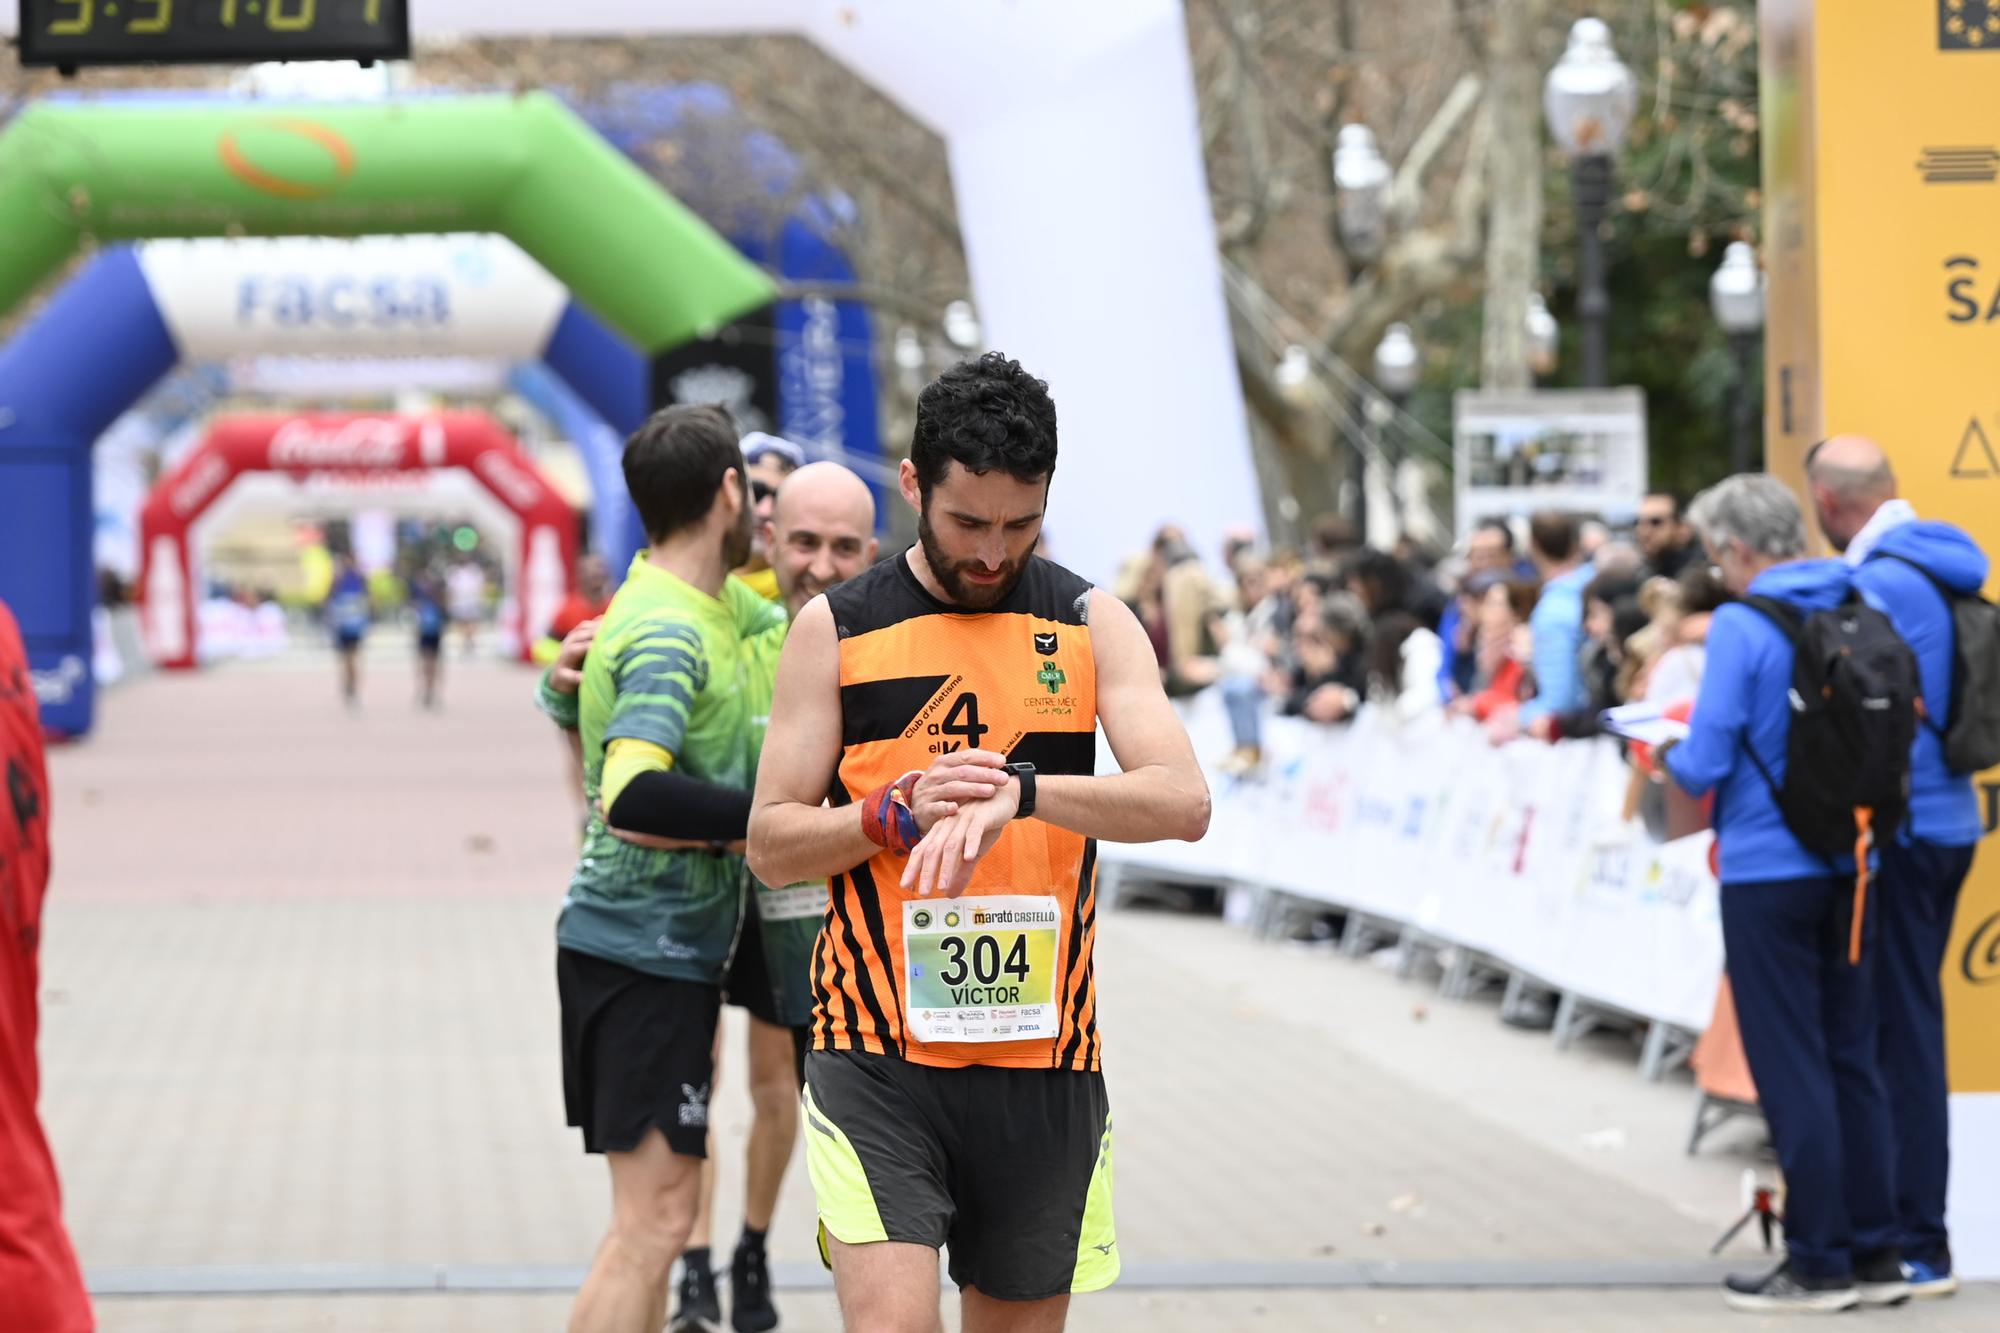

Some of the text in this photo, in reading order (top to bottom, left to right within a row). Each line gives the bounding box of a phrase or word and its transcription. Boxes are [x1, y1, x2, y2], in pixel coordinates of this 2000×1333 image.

[905, 674, 964, 739] Club d'Atletisme
[1024, 697, 1056, 707] CENTRE
[927, 692, 989, 749] a 4
[928, 741, 941, 754] el
[974, 909, 1055, 925] marató CASTELLÓ
[939, 933, 1030, 986] 304
[951, 983, 1020, 1005] VÍCTOR
